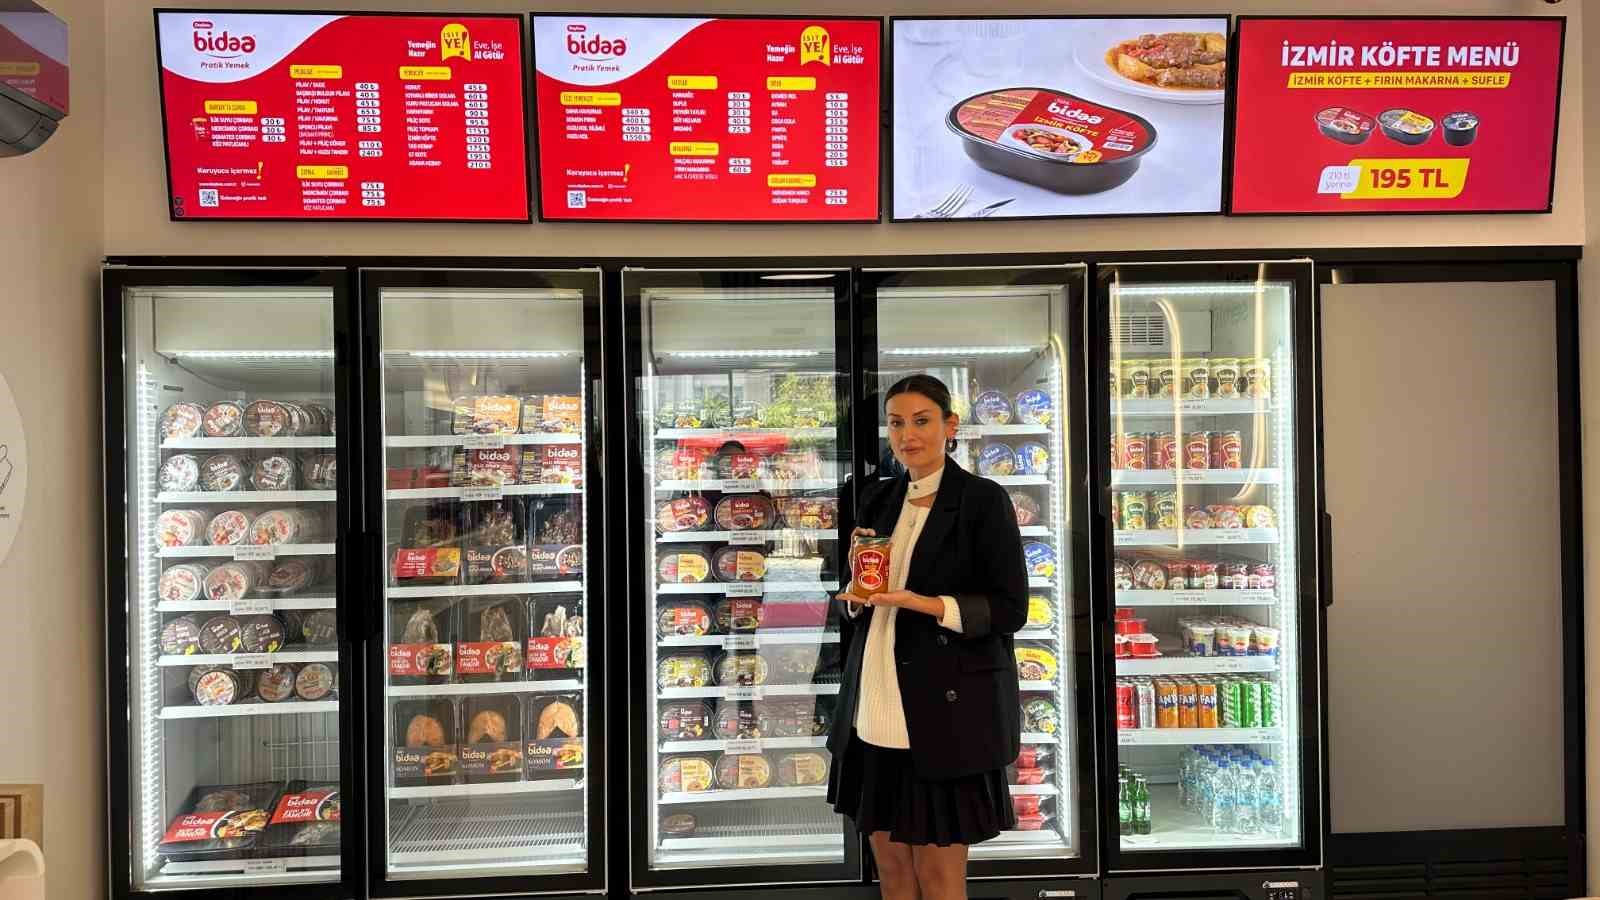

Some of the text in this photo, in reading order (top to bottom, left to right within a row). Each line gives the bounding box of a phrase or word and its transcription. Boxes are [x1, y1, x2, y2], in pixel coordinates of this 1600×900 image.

[194, 32, 256, 52] bidaa
[408, 40, 436, 49] Yemeğin
[474, 41, 490, 50] Eve,
[568, 34, 626, 56] bidaa
[766, 44, 796, 54] Yemeğin
[833, 44, 849, 54] Eve,
[1282, 40, 1520, 66] İZMİR KÖFTE MENÜ
[474, 51, 504, 59] Al Götür
[834, 54, 864, 64] Al Götür
[573, 64, 620, 72] Pratik Yemek
[1293, 74, 1324, 85] İZMİR
[1374, 76, 1402, 85] FIRIN
[1405, 76, 1459, 85] MAKARNA
[1471, 76, 1505, 85] SUFLE
[1048, 102, 1103, 124] bidaa
[1370, 168, 1449, 188] 195 TL
[480, 451, 511, 461] bidaa
[548, 448, 578, 458] bidaa
[532, 551, 555, 560] bidaa
[462, 751, 486, 759] bidaa
[528, 746, 552, 755] bidaa
[396, 754, 419, 762] bidaa
